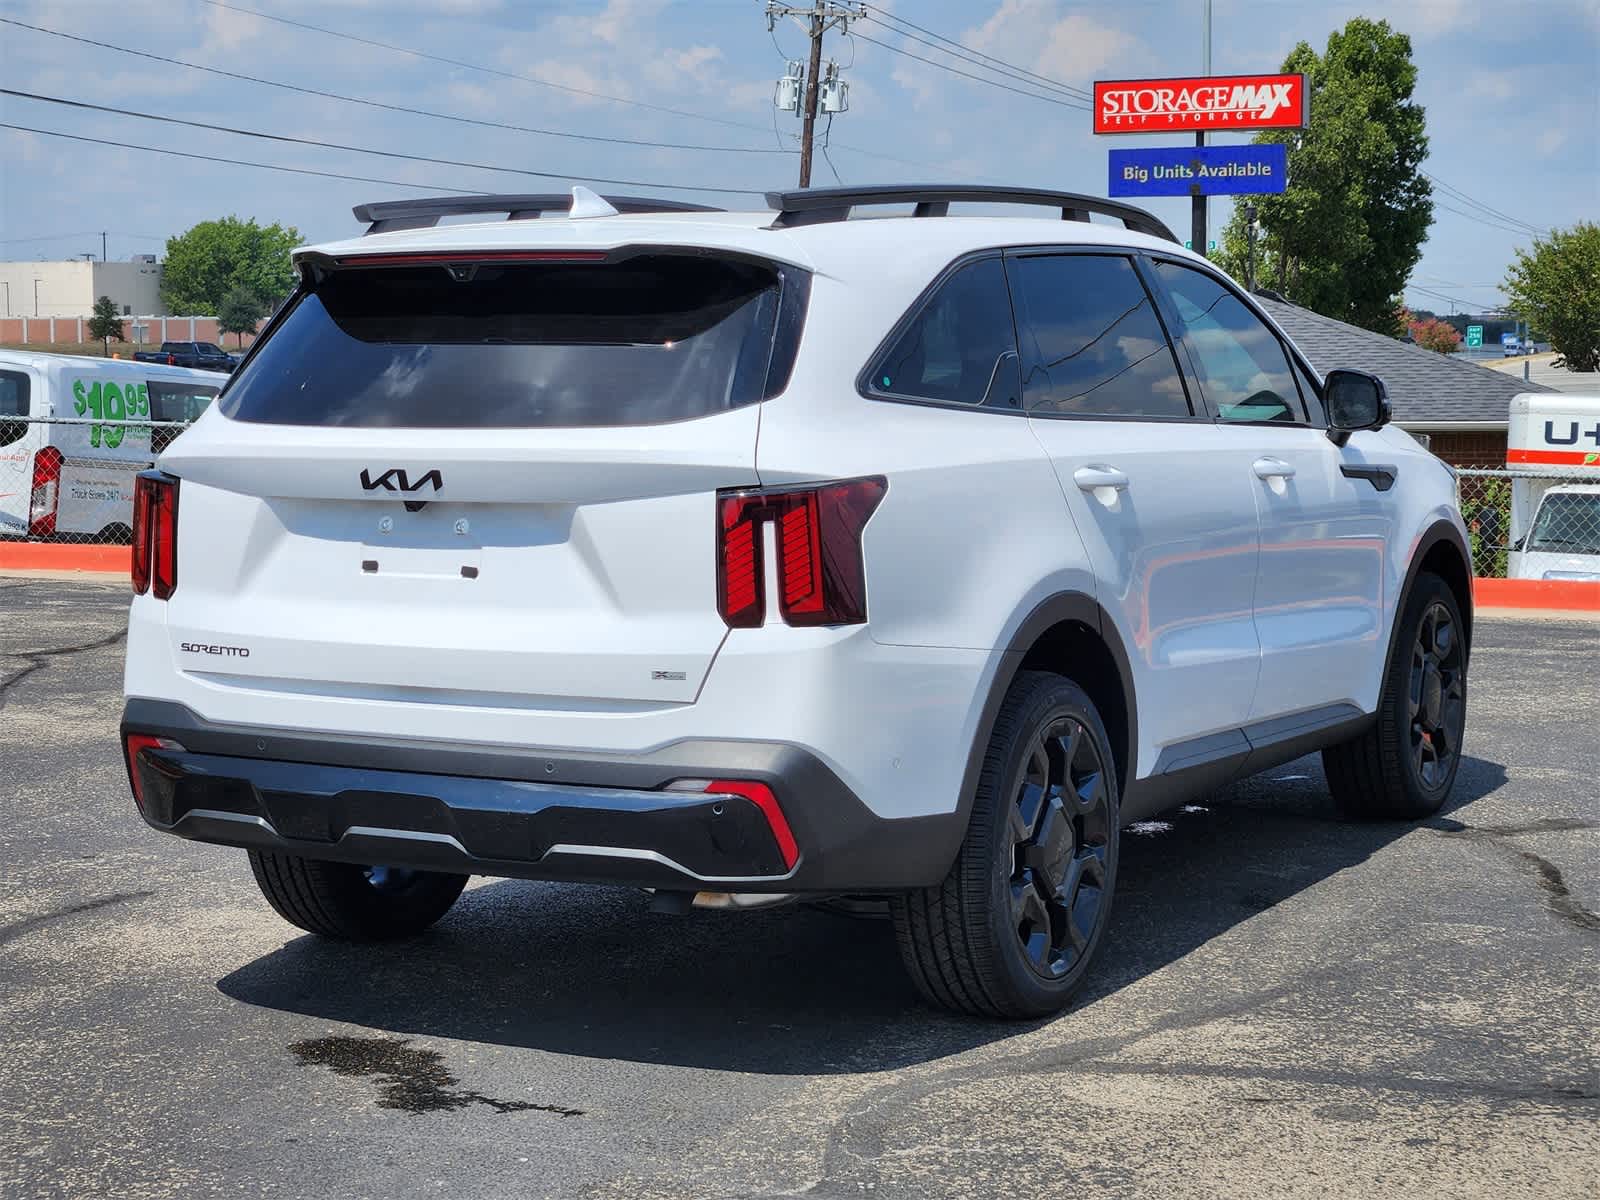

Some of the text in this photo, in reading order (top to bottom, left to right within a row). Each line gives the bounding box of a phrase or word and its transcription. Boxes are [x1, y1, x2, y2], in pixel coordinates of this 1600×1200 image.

[1103, 111, 1257, 124] SELF STORAGE
[1124, 163, 1271, 182] Big Units Available
[1545, 421, 1600, 446] U-
[360, 468, 443, 491] KIA
[181, 642, 249, 657] SORENTO
